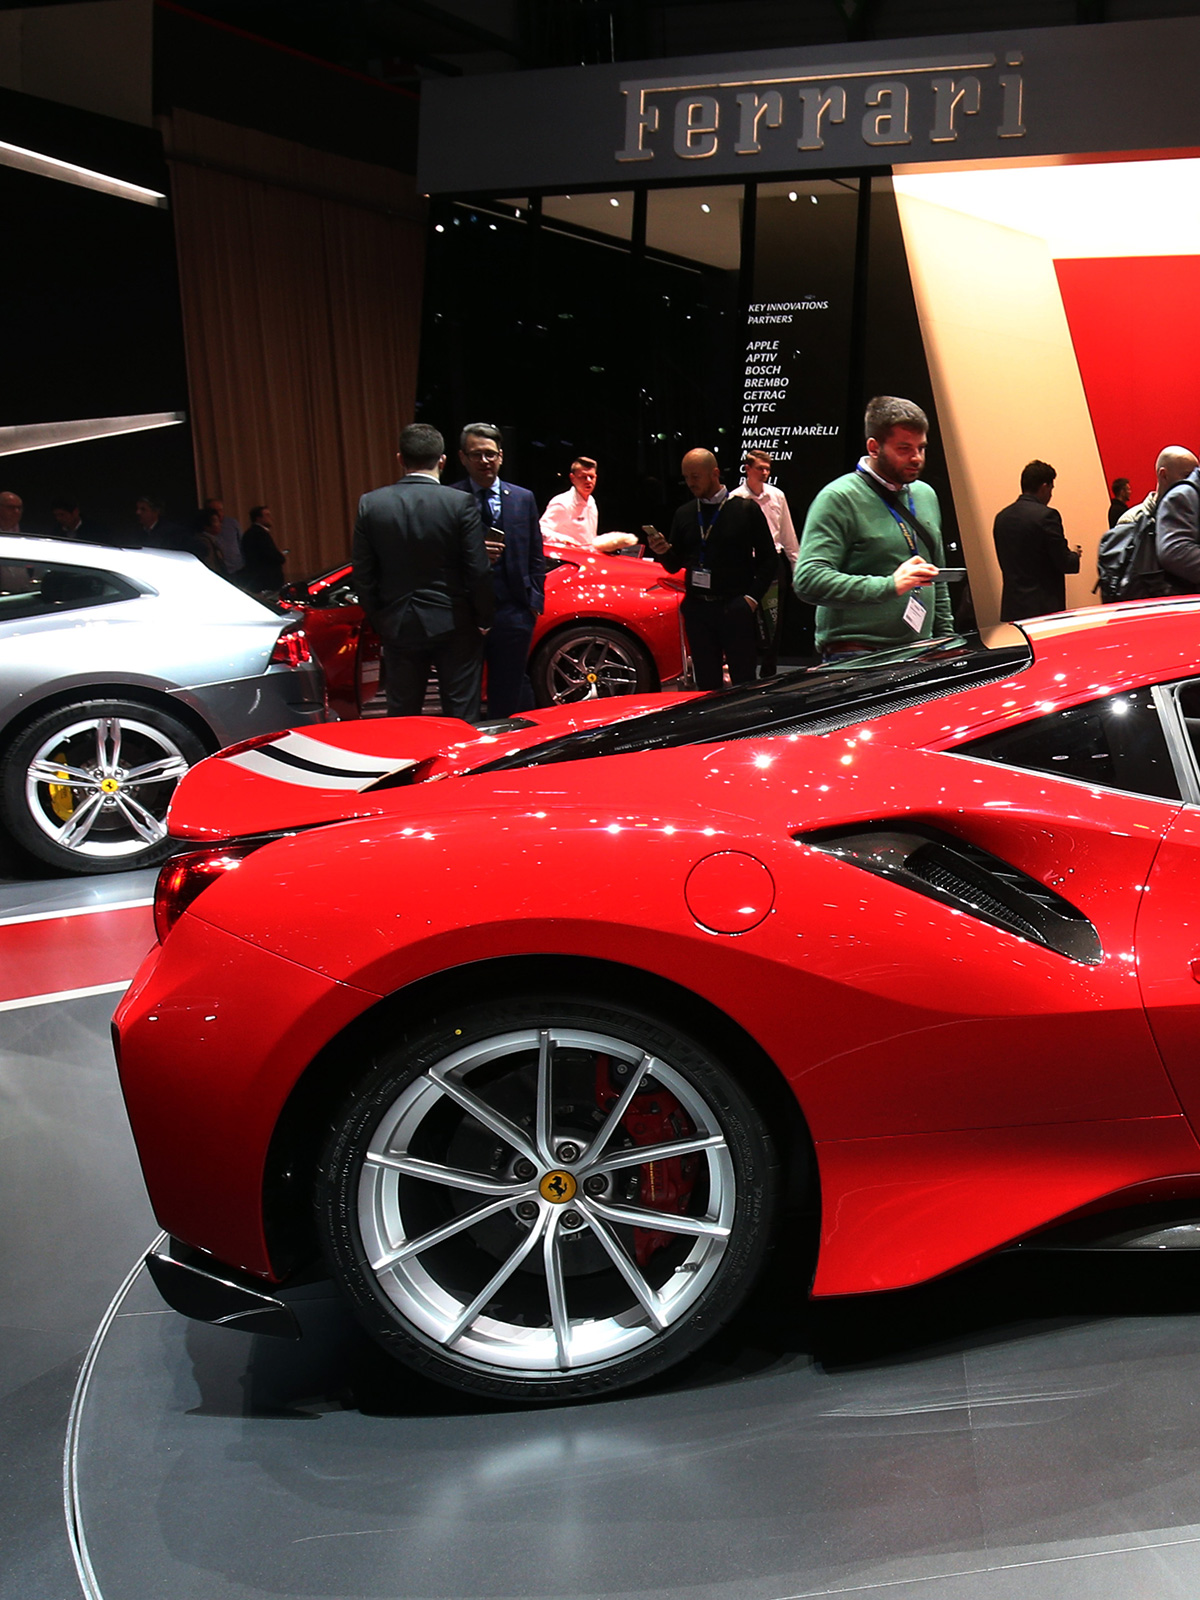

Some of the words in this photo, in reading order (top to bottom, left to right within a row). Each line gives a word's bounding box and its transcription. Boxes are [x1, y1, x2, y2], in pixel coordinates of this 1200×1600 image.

[614, 52, 1026, 162] Ferrari
[748, 303, 767, 313] KEY
[766, 300, 829, 312] INNOVATIONS
[747, 314, 793, 325] PARTNERS
[745, 340, 780, 351] APPLE
[745, 352, 778, 363] APTIV
[744, 365, 782, 375] BOSCH
[744, 377, 790, 388] BREMBO
[743, 389, 786, 400] GETRAG
[742, 402, 777, 413] CYTEC
[742, 414, 758, 424] IHI
[741, 426, 791, 437] MAGNETI
[791, 425, 840, 436] MARELLI
[741, 439, 780, 449] MAHLE
